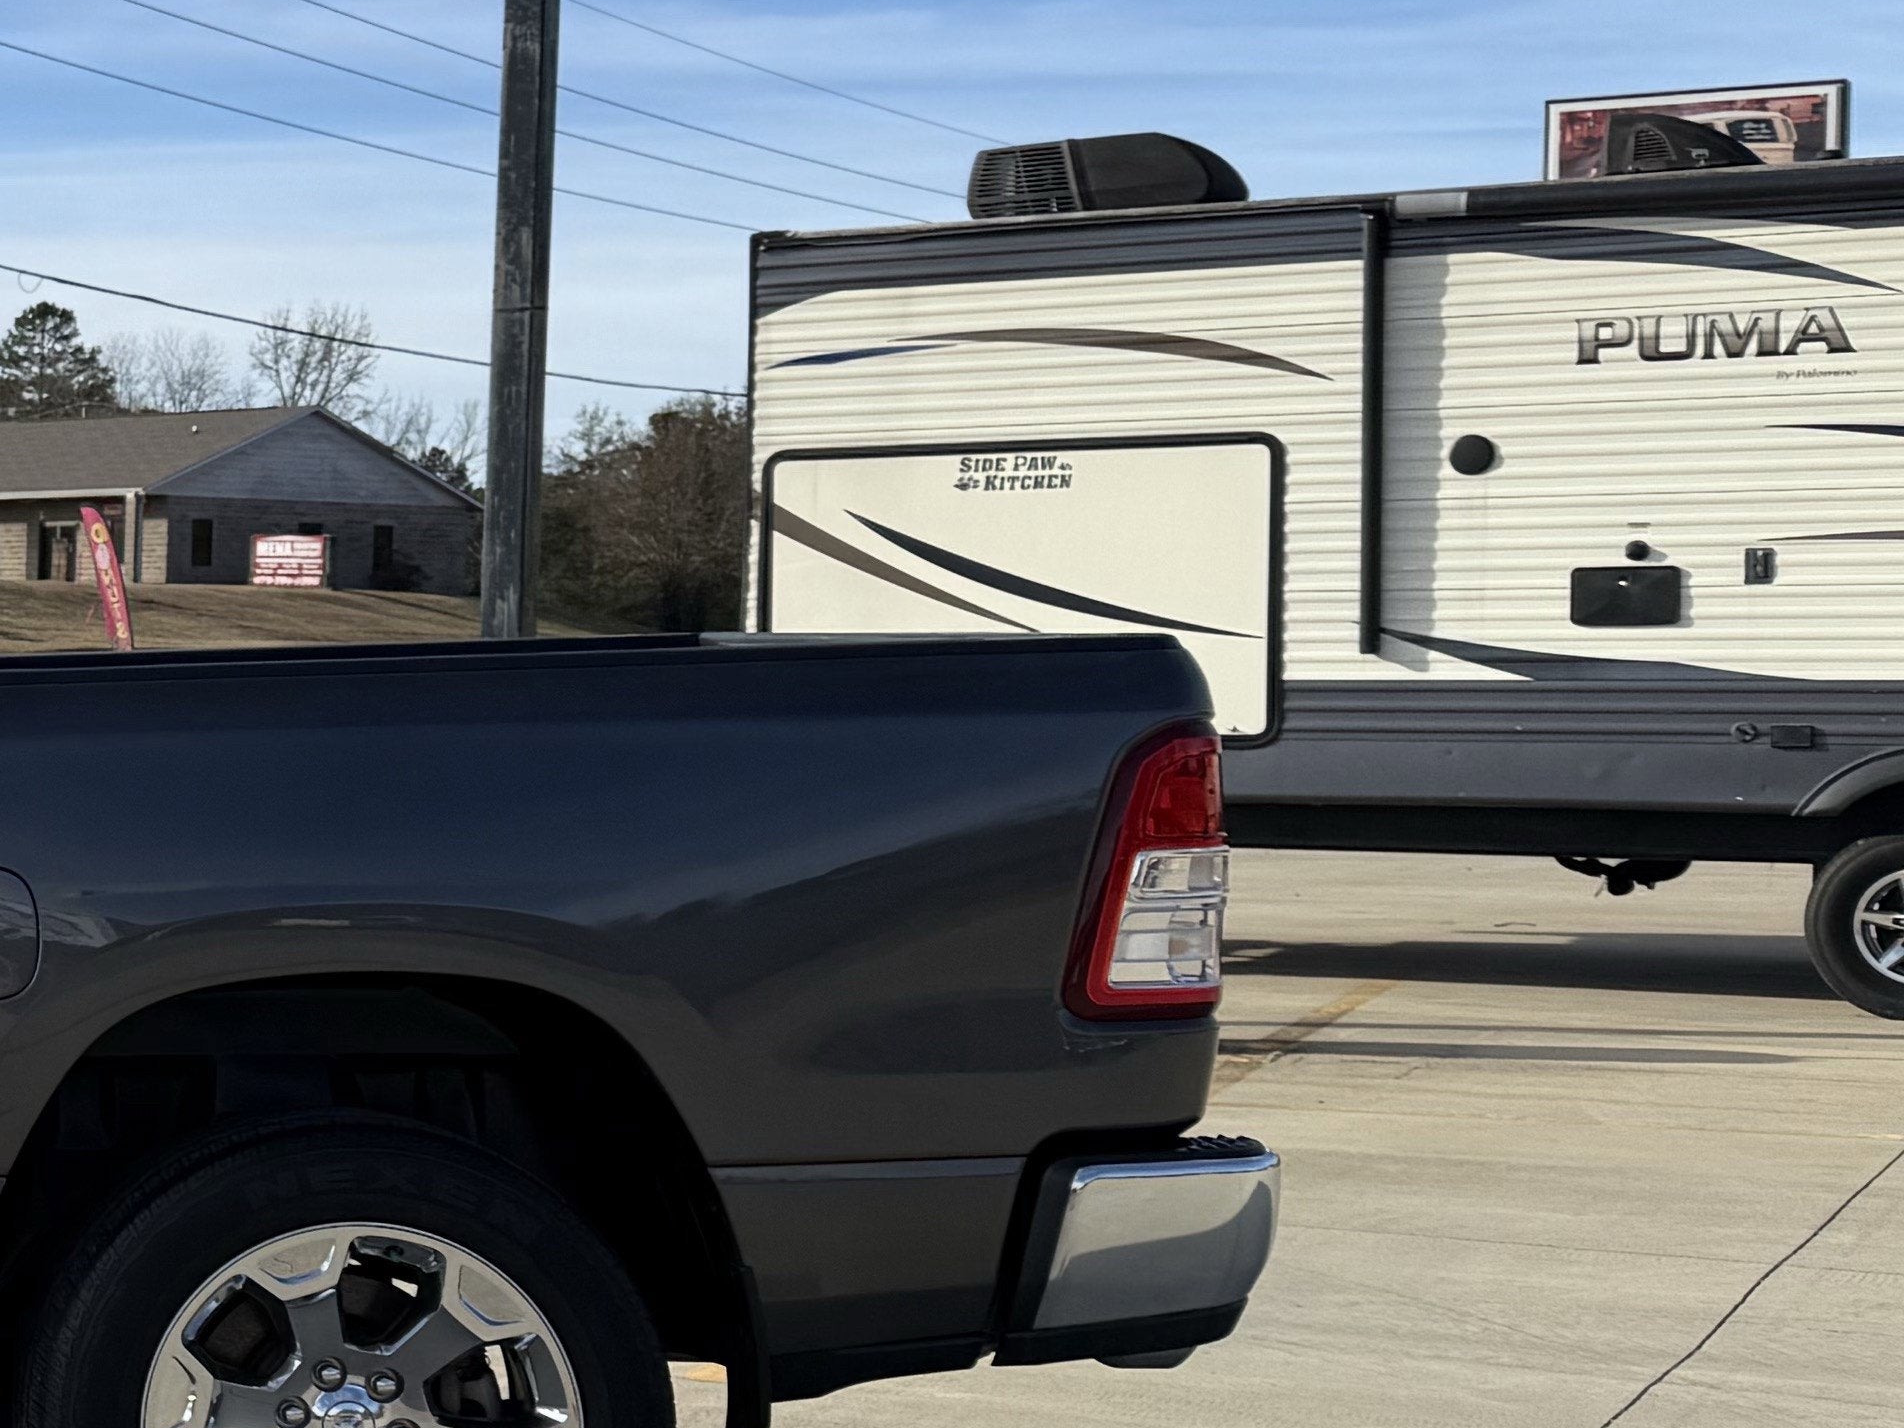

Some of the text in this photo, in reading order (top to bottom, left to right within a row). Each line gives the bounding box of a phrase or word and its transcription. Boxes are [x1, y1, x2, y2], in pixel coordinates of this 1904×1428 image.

[1575, 305, 1857, 366] PUMA
[959, 456, 1058, 473] SIDE PAW
[983, 474, 1072, 491] KITCHEN
